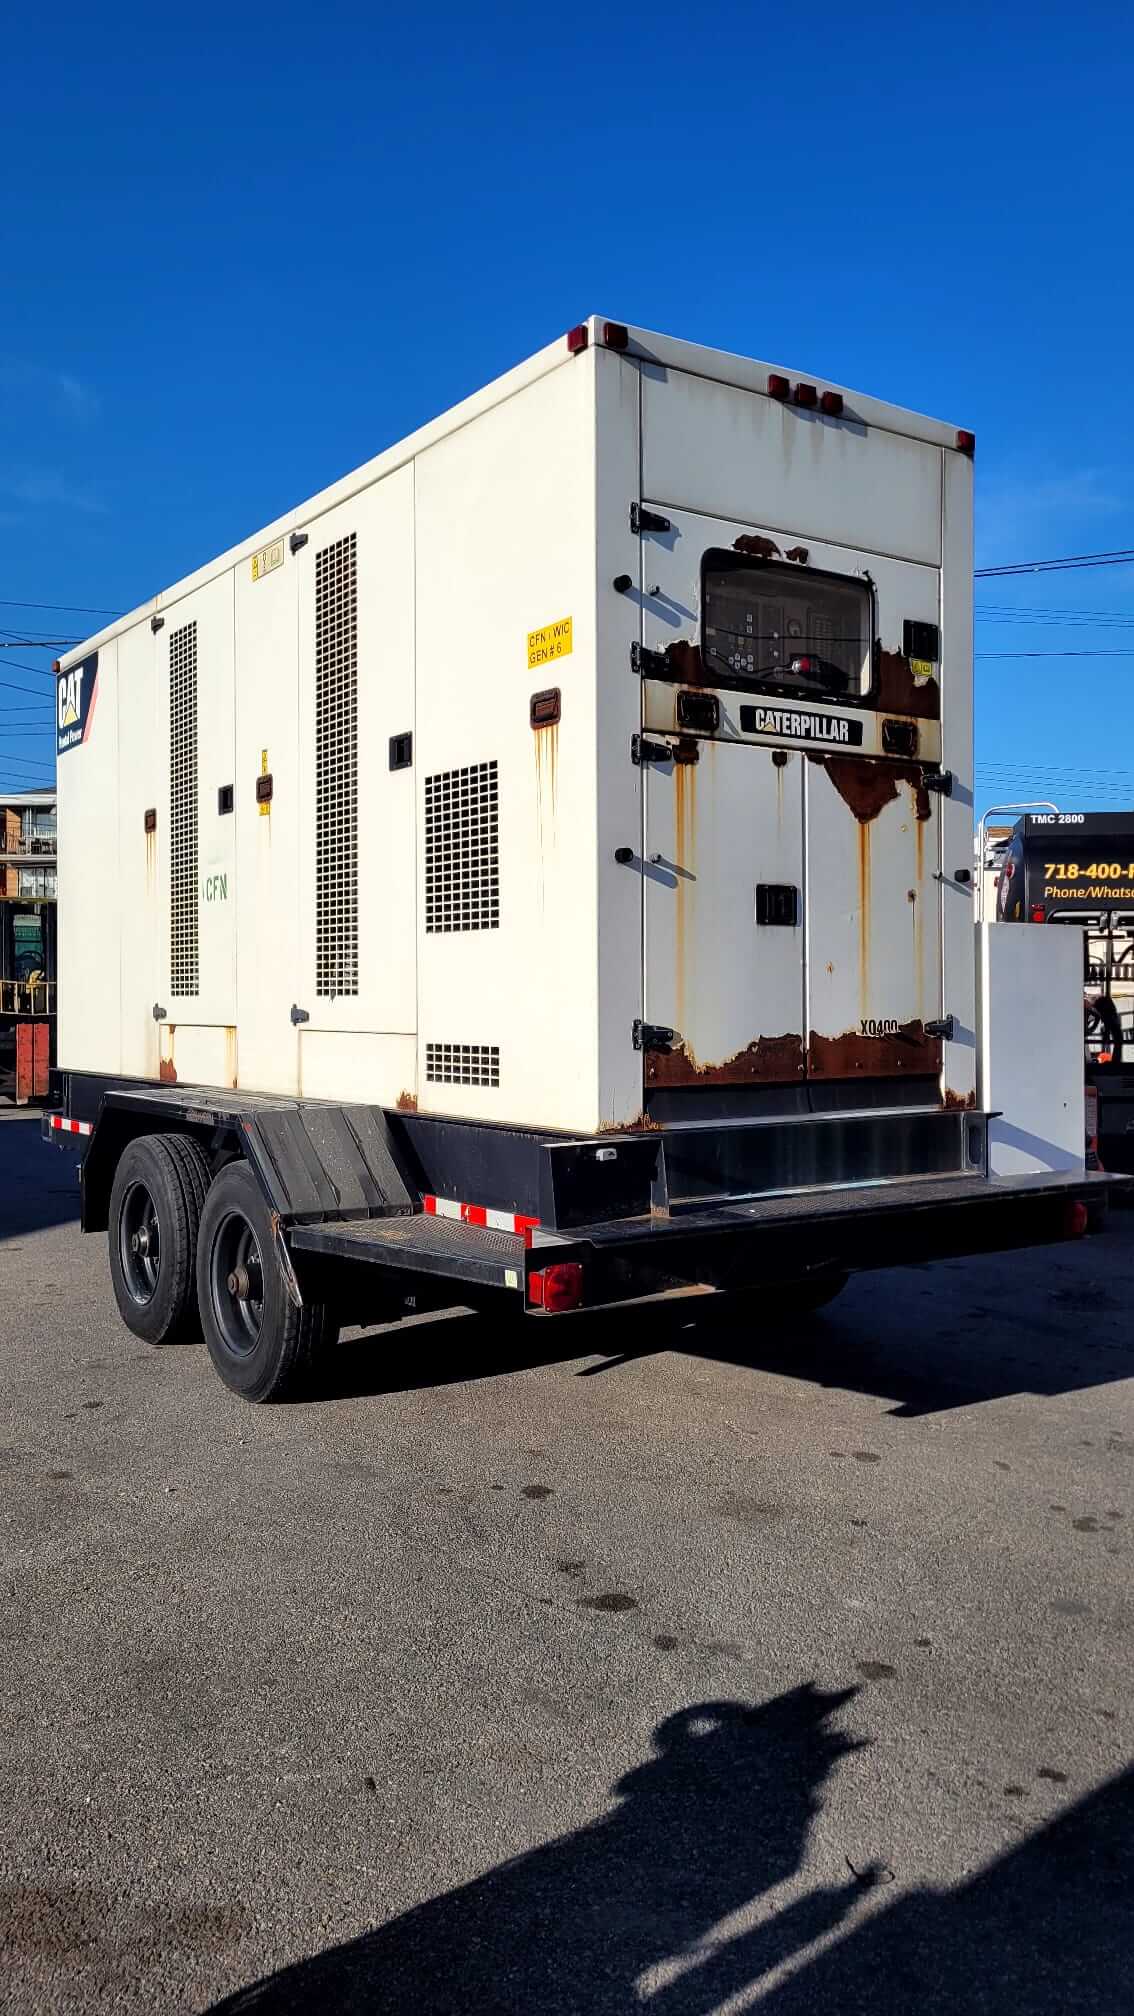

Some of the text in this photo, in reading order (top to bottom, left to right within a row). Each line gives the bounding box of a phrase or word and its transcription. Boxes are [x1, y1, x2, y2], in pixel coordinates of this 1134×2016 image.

[529, 632, 546, 647] CFN
[553, 622, 569, 638] WIC
[530, 641, 562, 664] GEN # 6
[59, 667, 84, 729] CAT
[755, 708, 849, 742] CATERPILLAR
[1031, 814, 1085, 824] TMC 2800
[206, 872, 227, 902] CFN
